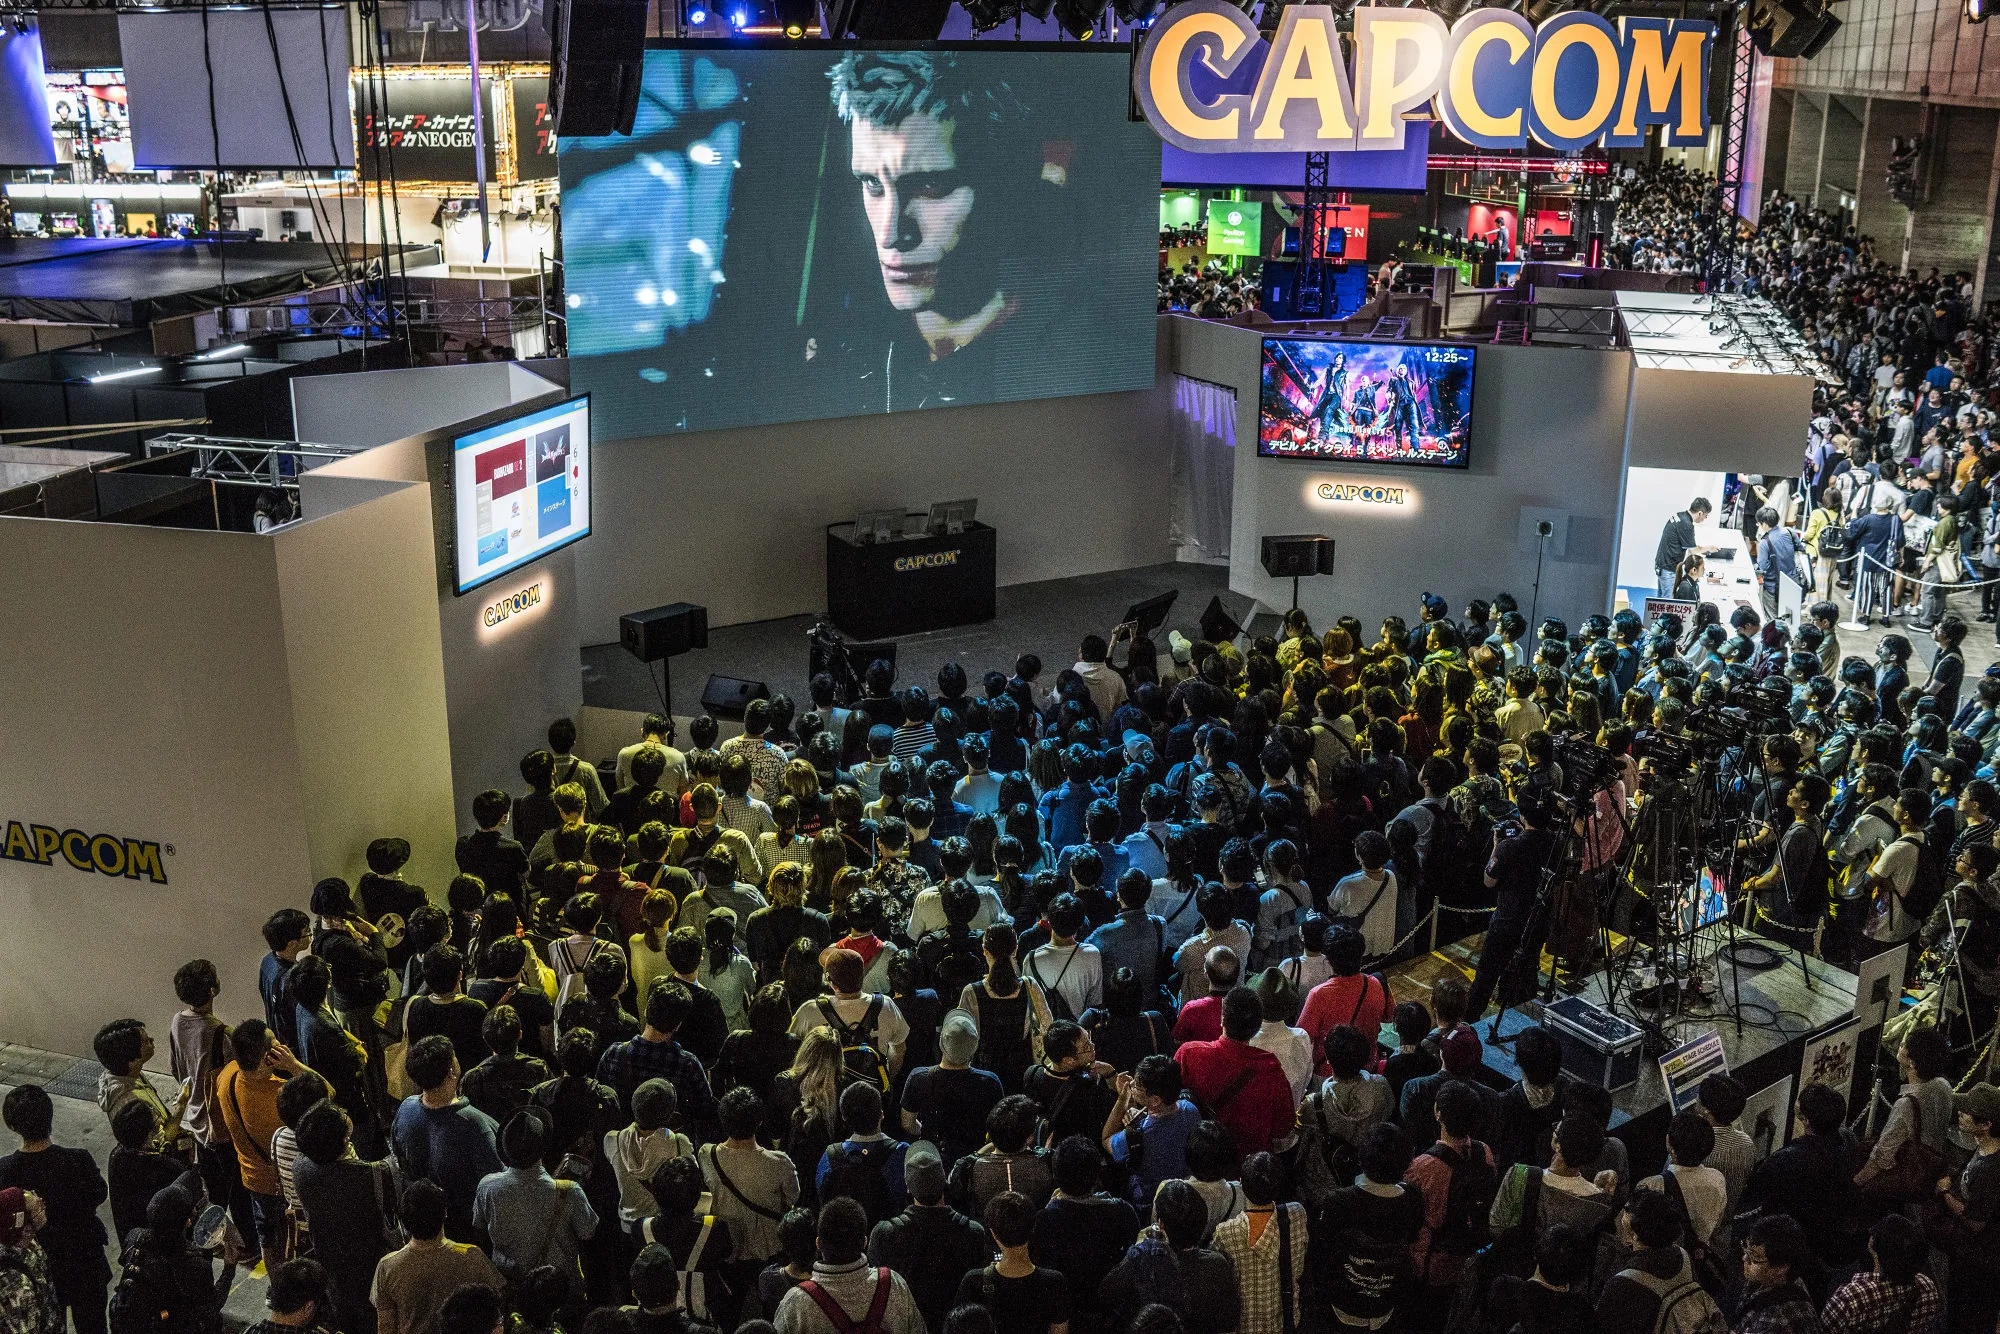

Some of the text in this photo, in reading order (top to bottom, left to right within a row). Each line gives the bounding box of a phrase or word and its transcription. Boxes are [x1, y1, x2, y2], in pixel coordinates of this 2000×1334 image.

[1141, 6, 1710, 150] CAPCOM
[1318, 227, 1365, 238] OEN
[1269, 440, 1458, 460] デビル メイ クライ 5 スペシャルステージ
[1318, 484, 1404, 504] CAPCOM
[894, 551, 958, 571] CAPCOM
[484, 584, 540, 627] CAPCOM
[1647, 603, 1692, 614] 関係者以外
